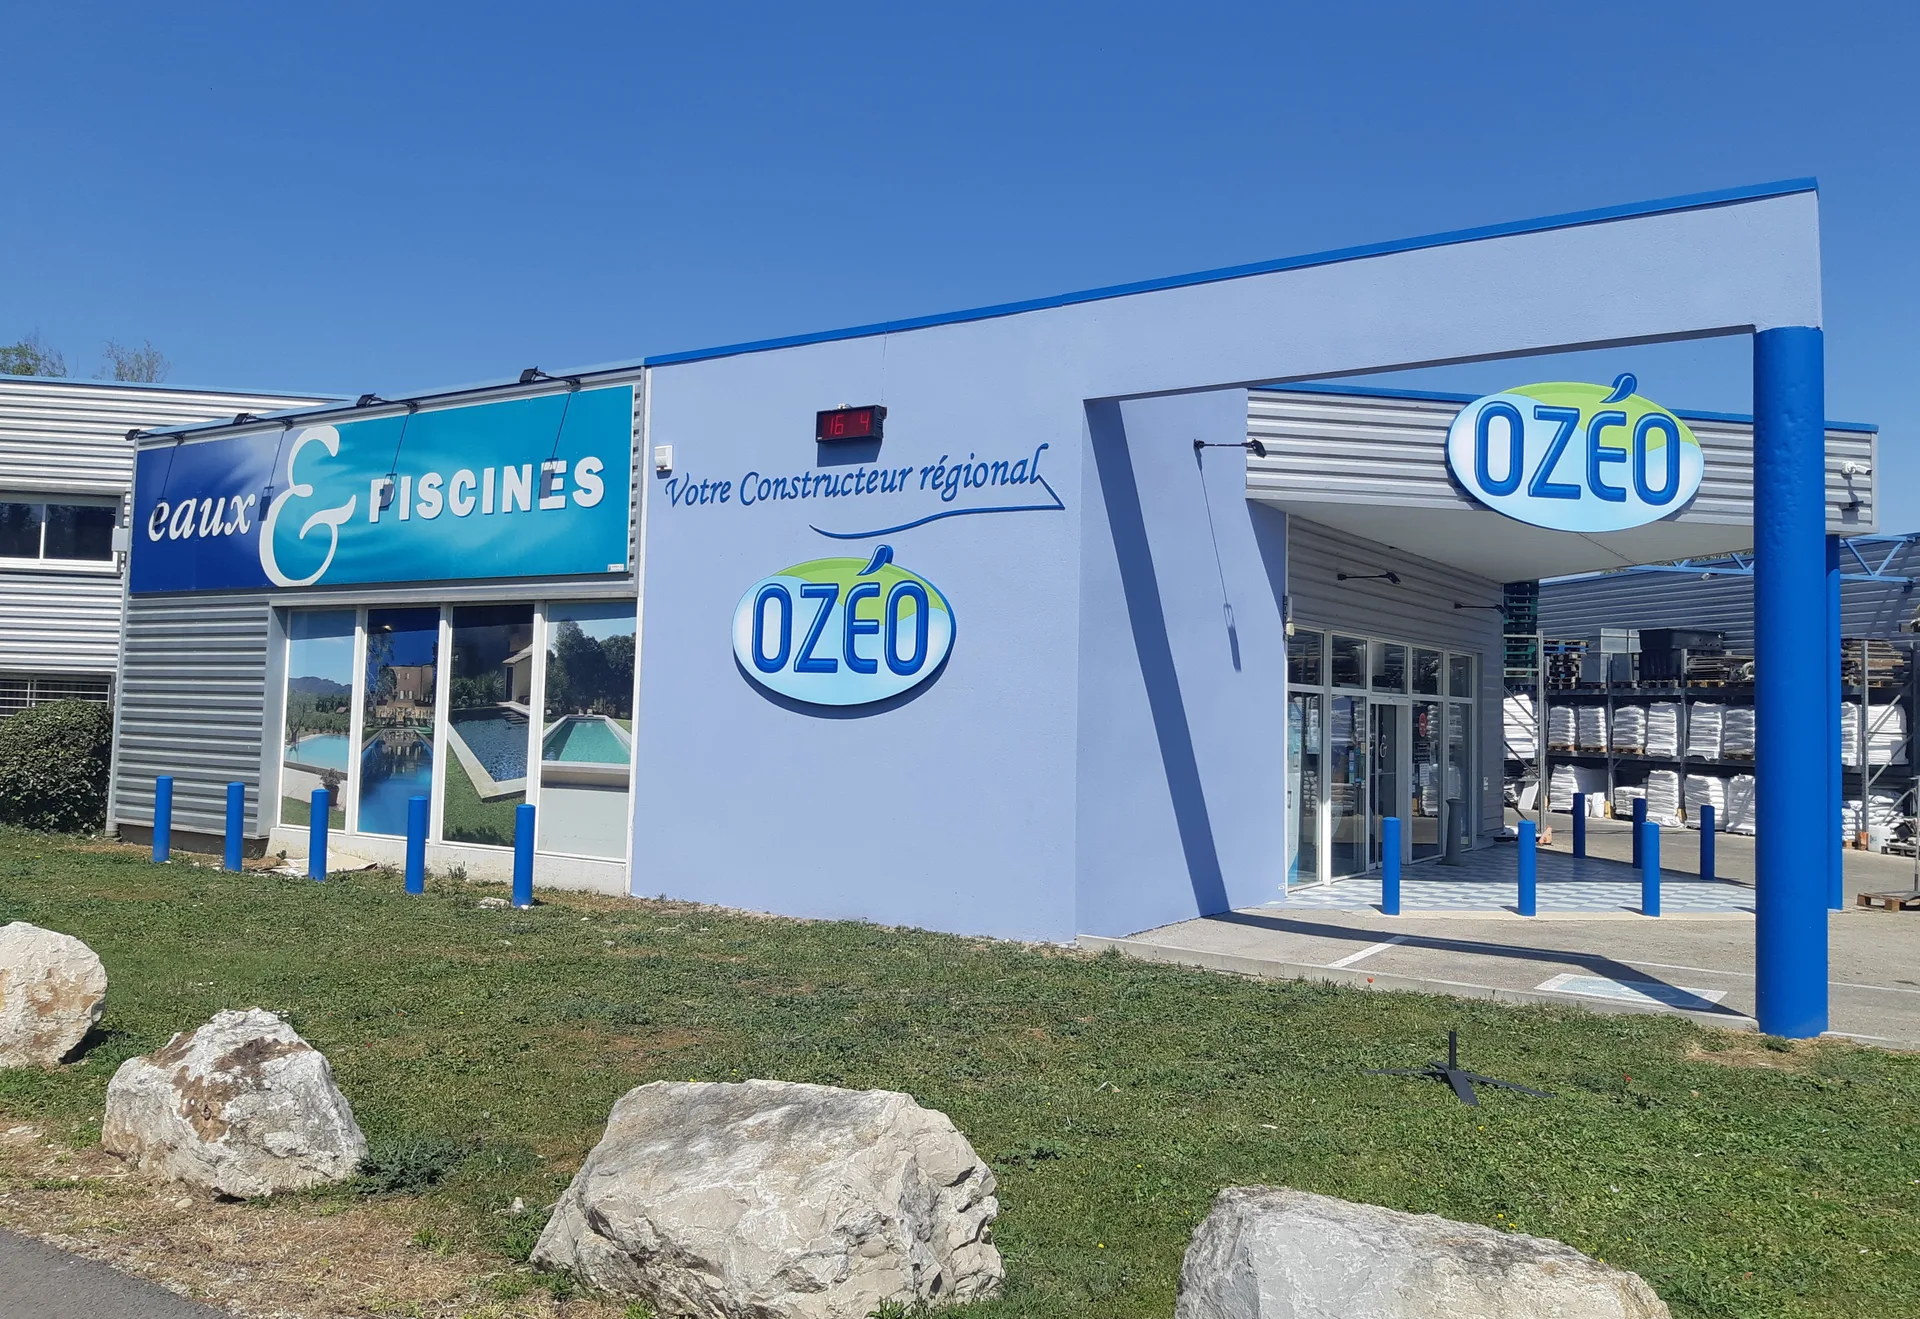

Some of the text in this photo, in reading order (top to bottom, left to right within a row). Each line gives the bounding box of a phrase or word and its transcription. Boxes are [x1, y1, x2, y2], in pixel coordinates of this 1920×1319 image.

[665, 443, 1050, 508] Votre Constructeur régional
[829, 414, 845, 436] 16
[1474, 372, 1681, 506] OZÉO
[147, 425, 605, 588] eaux & PISCINES
[751, 544, 930, 677] OZÉO
